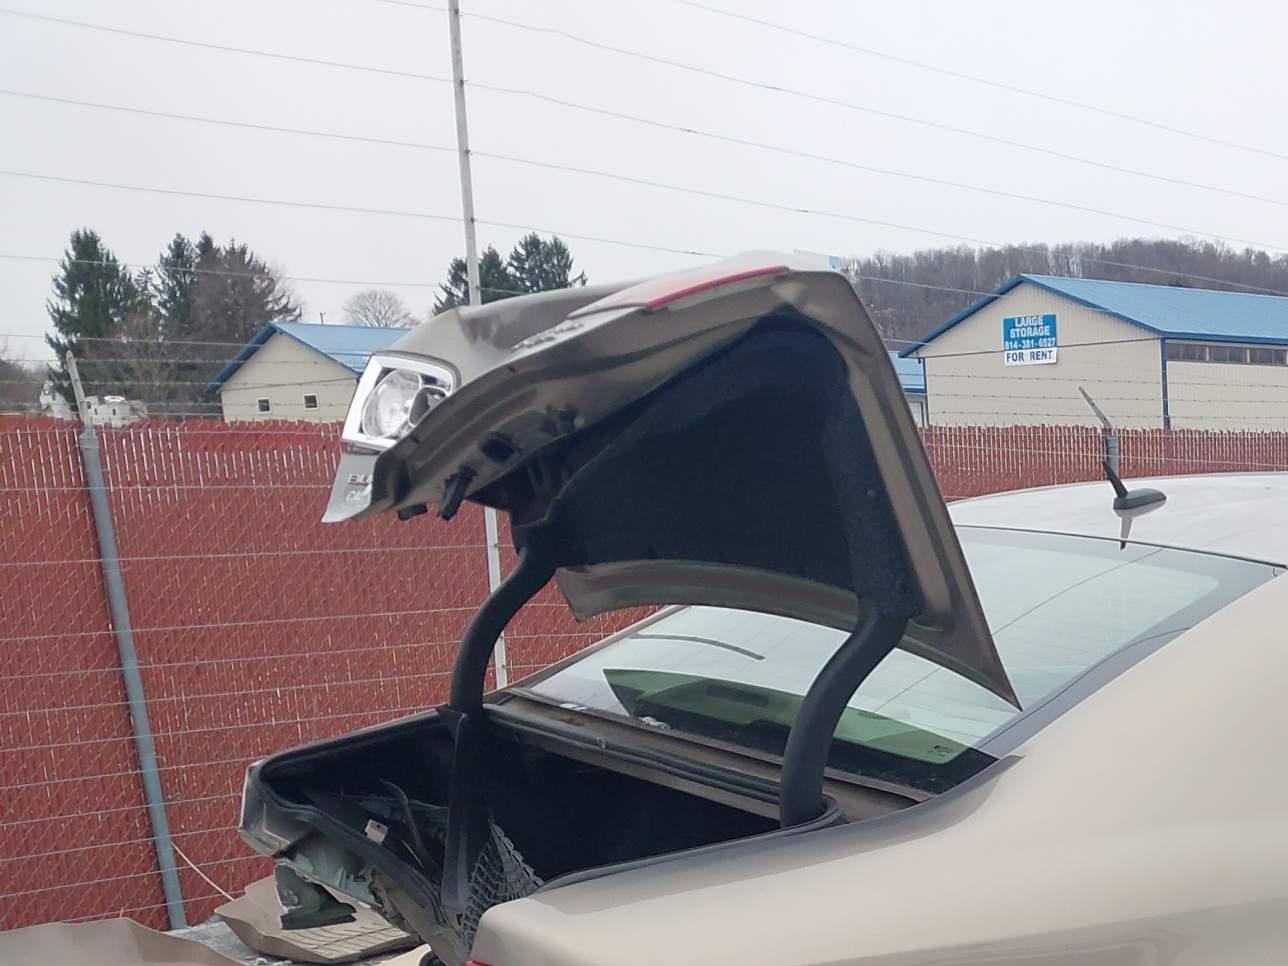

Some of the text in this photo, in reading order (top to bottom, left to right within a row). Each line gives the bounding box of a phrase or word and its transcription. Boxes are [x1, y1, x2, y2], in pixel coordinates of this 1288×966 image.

[1014, 315, 1044, 327] LARGE
[1009, 325, 1051, 338] STORAGE
[1006, 350, 1053, 362] FOR RENT
